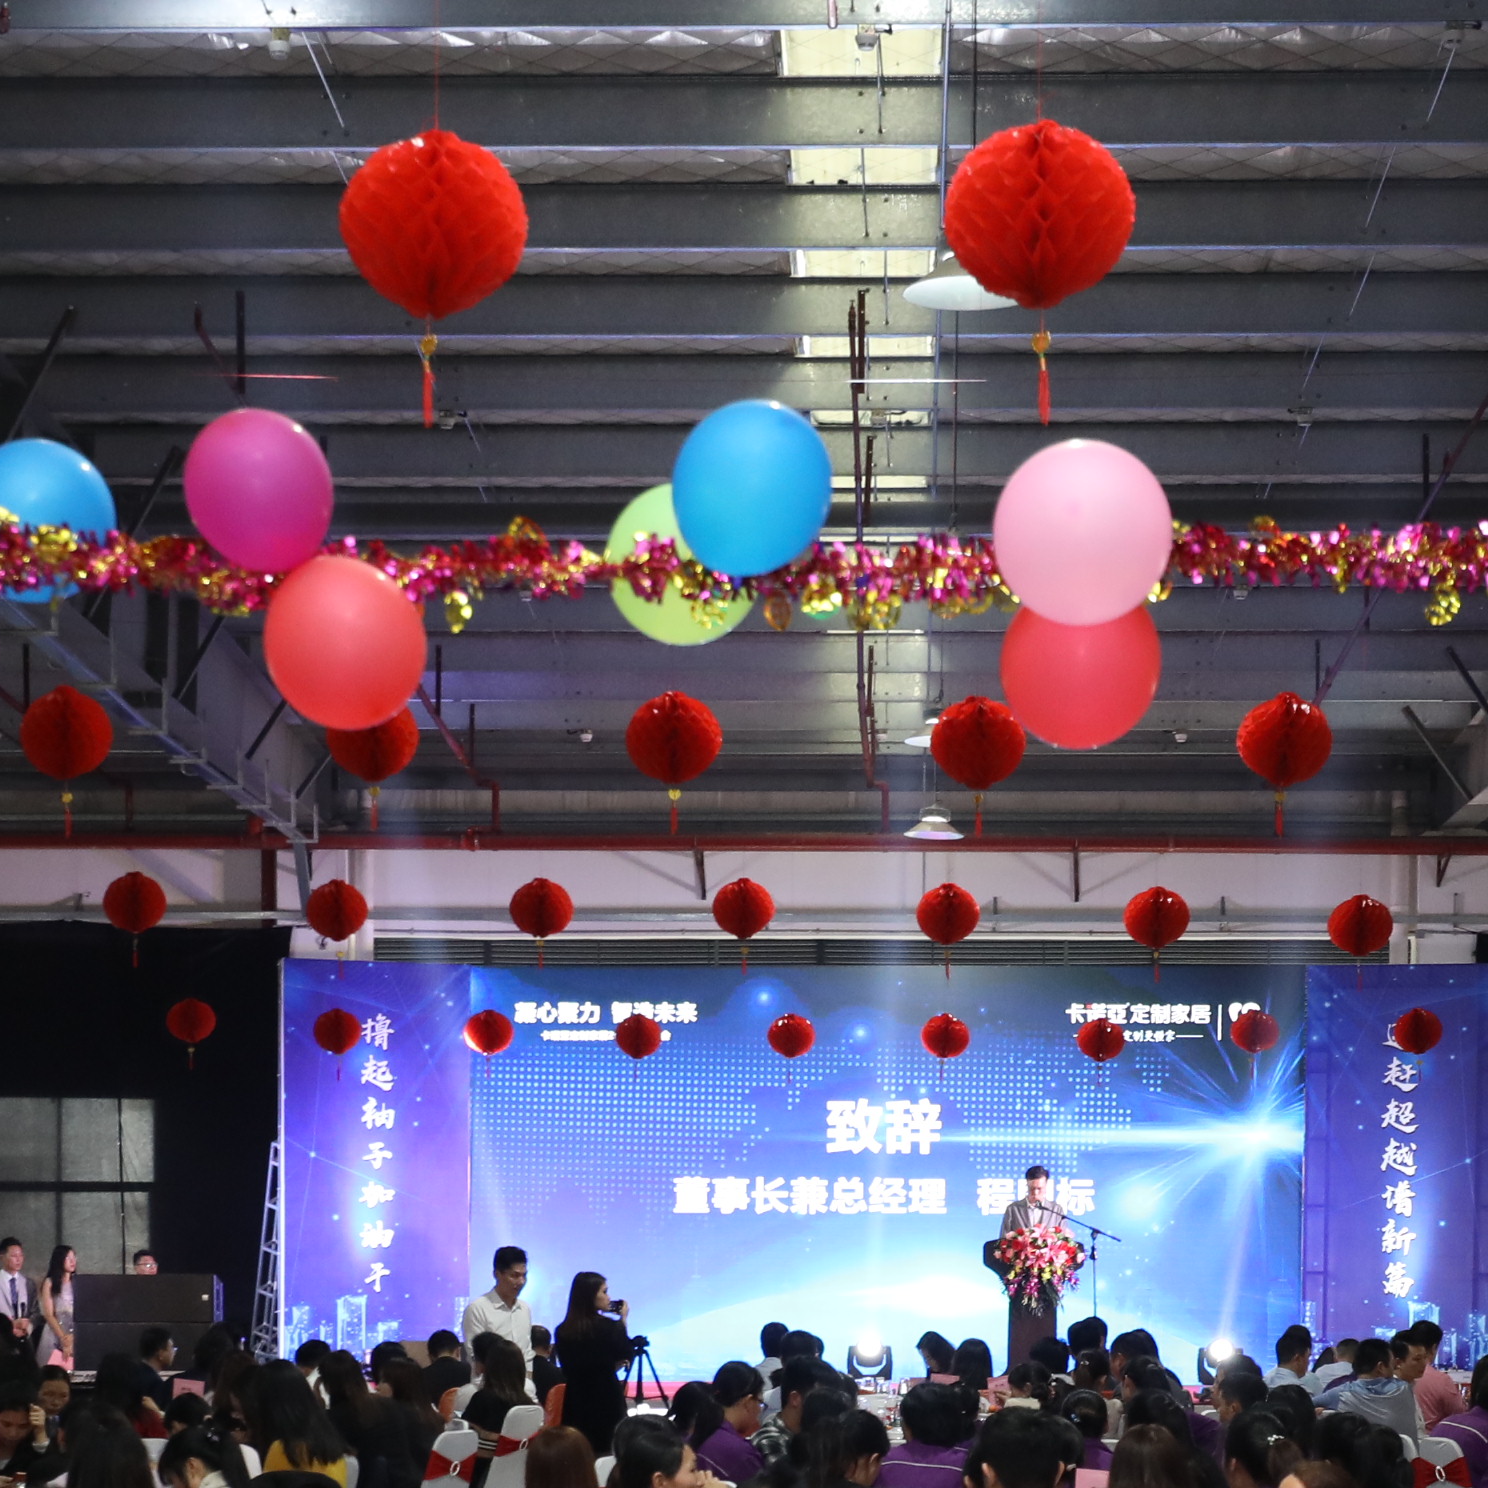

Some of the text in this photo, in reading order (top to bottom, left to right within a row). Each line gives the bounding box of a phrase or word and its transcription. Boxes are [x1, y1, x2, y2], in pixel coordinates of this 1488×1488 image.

[359, 1013, 395, 1293] 撸起袖子加油干
[826, 1098, 943, 1155] 致辞
[673, 1176, 947, 1215] 董事长兼总经理
